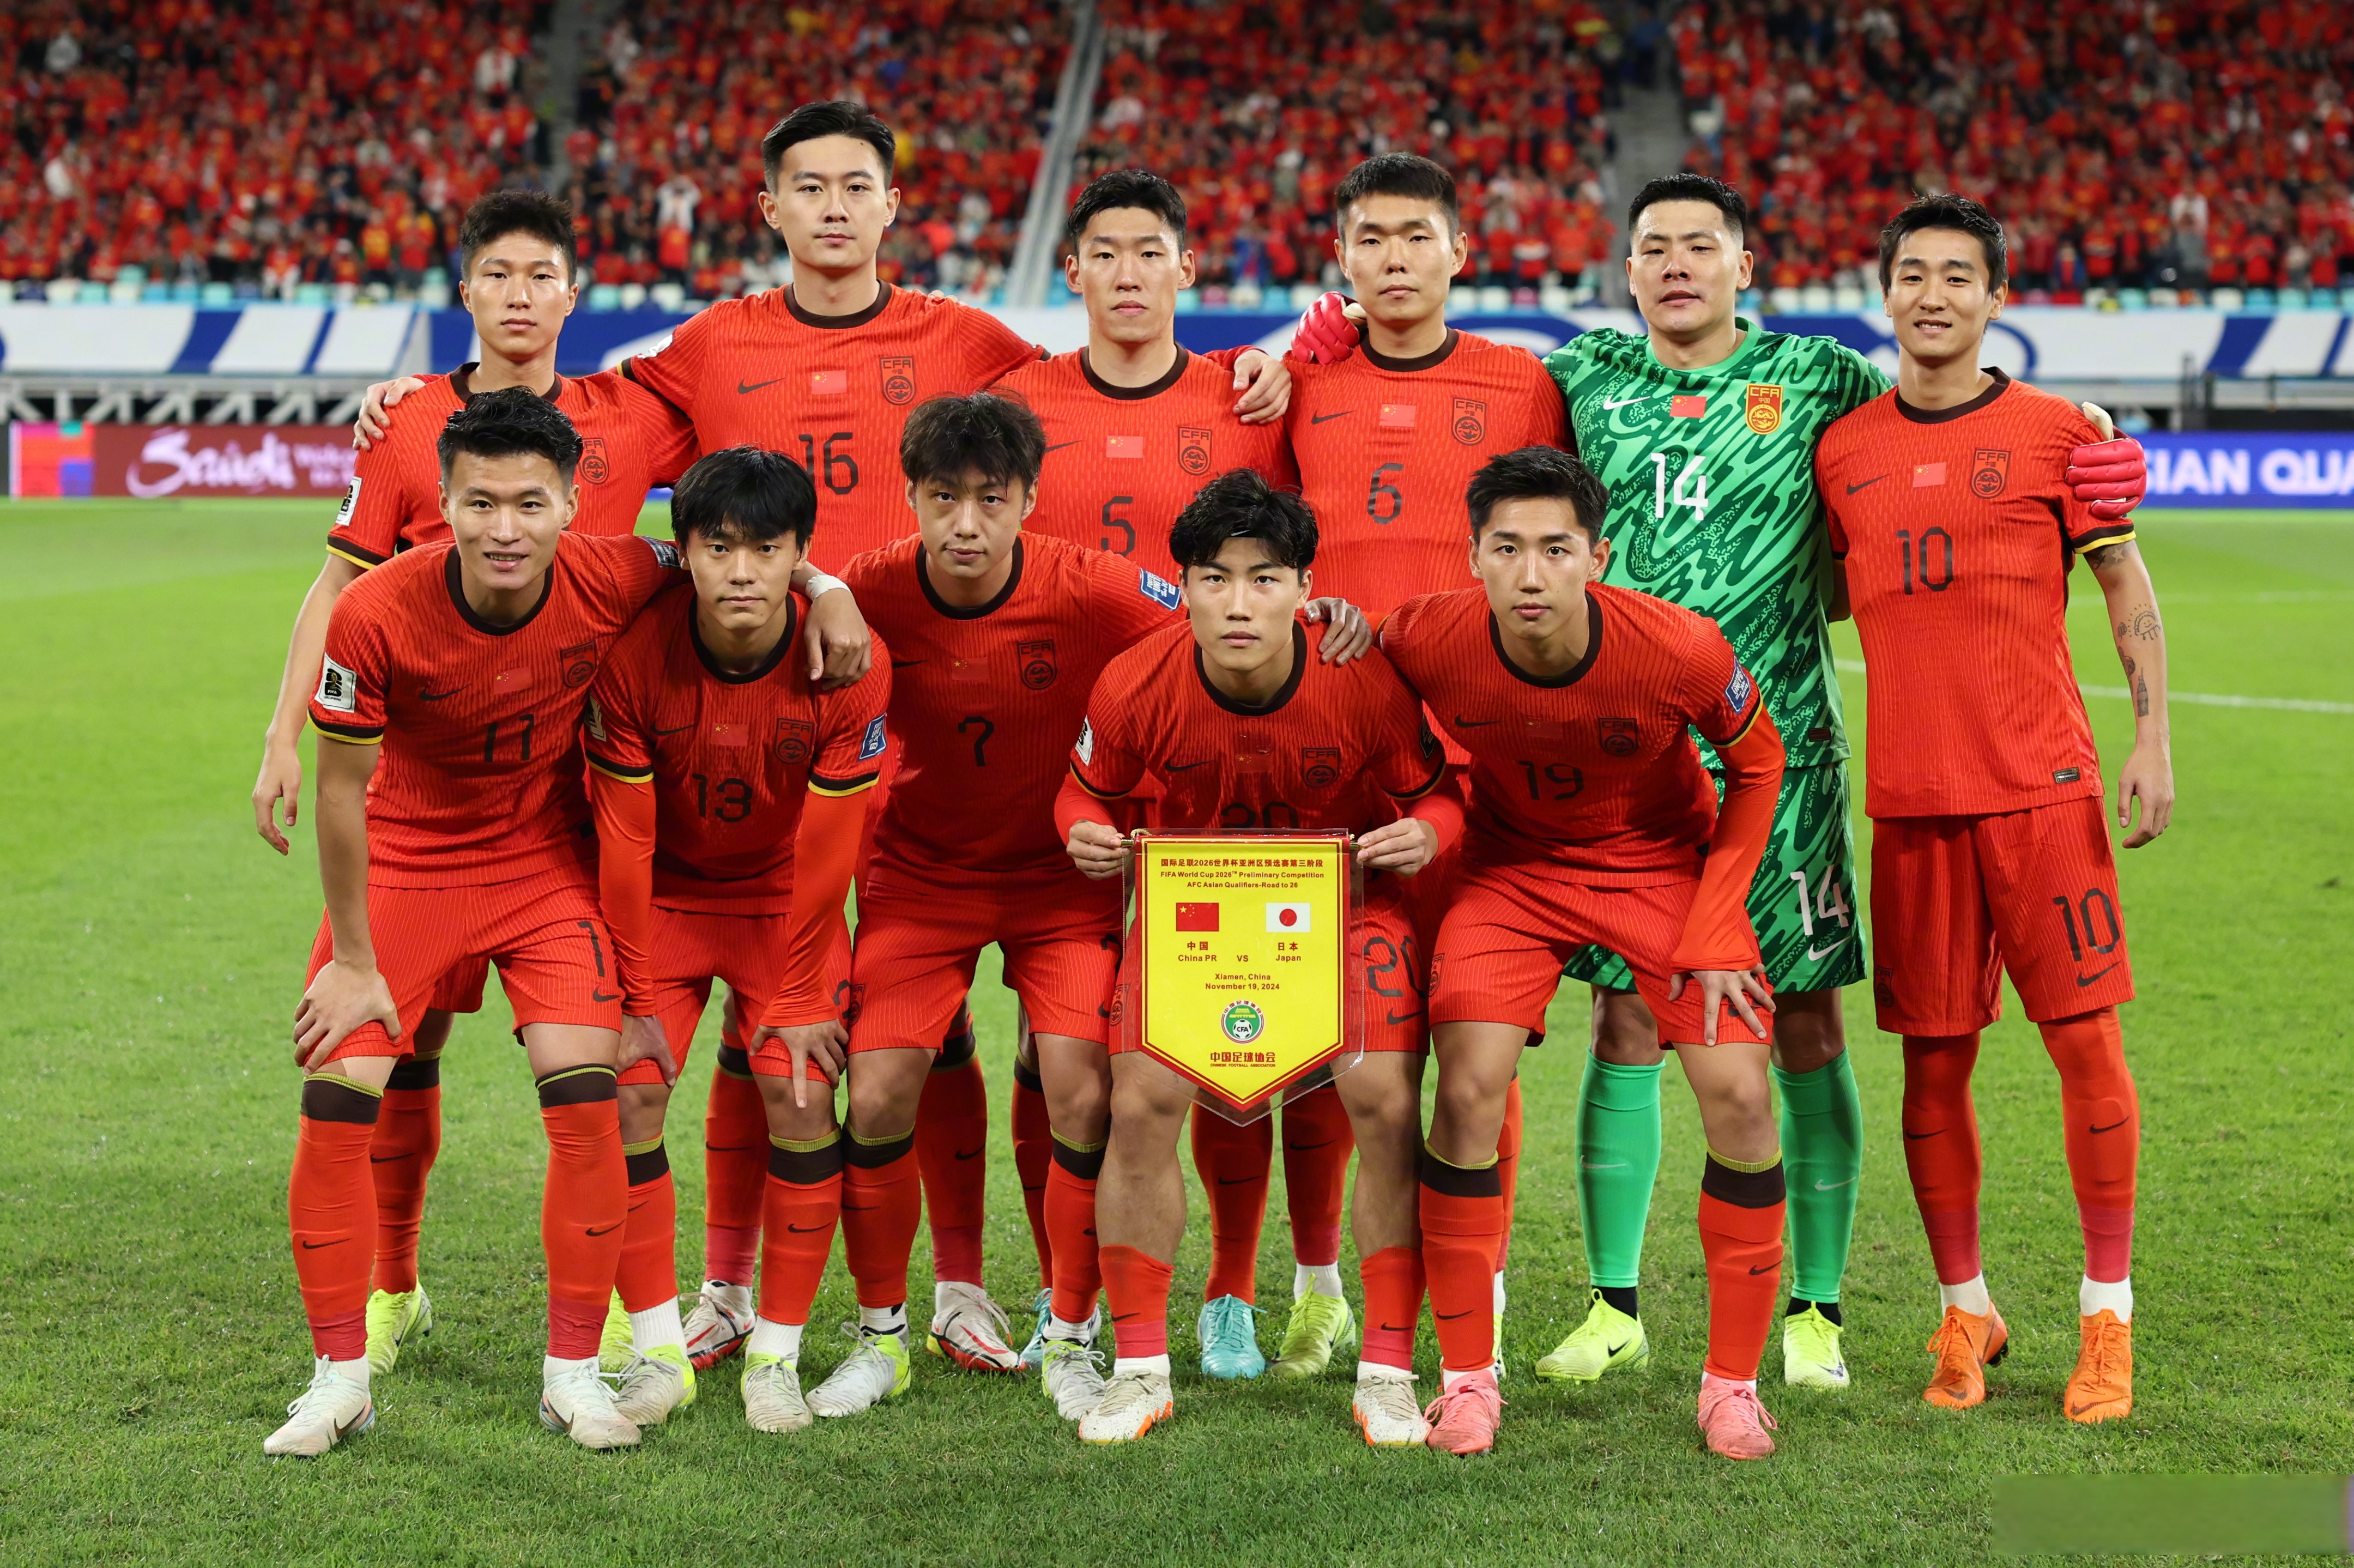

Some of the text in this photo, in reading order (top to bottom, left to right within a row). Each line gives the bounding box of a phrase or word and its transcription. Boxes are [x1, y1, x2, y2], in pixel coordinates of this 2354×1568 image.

[883, 360, 911, 369] CFA
[1750, 387, 1780, 398] CFA
[1456, 401, 1484, 412] CFA
[1182, 430, 1209, 440] CFA
[583, 440, 603, 450] FA
[1976, 452, 2006, 462] CFA
[798, 432, 859, 495] 16
[2146, 449, 2250, 495] IAN
[1650, 452, 1709, 520] 14
[1367, 463, 1404, 525] 6
[1100, 495, 1135, 556] 5
[1896, 525, 1953, 595] 10
[564, 644, 594, 659] CFA
[1021, 643, 1051, 655] CFA
[779, 722, 810, 733] CFA
[957, 716, 994, 767] 7
[1305, 750, 1336, 759] CFA
[1518, 760, 1584, 801] 19
[692, 773, 753, 822] 13
[1161, 858, 1323, 867] 国际足联2026世界杯亚洲区预选赛第三阶段
[1790, 864, 1850, 936] 14
[2053, 888, 2120, 962] 10
[1187, 941, 1208, 951] 中国
[1278, 941, 1299, 952] 日本
[1275, 954, 1302, 962] Japan
[1363, 936, 1426, 998] 20
[1211, 1052, 1275, 1062] 中国足球协会
